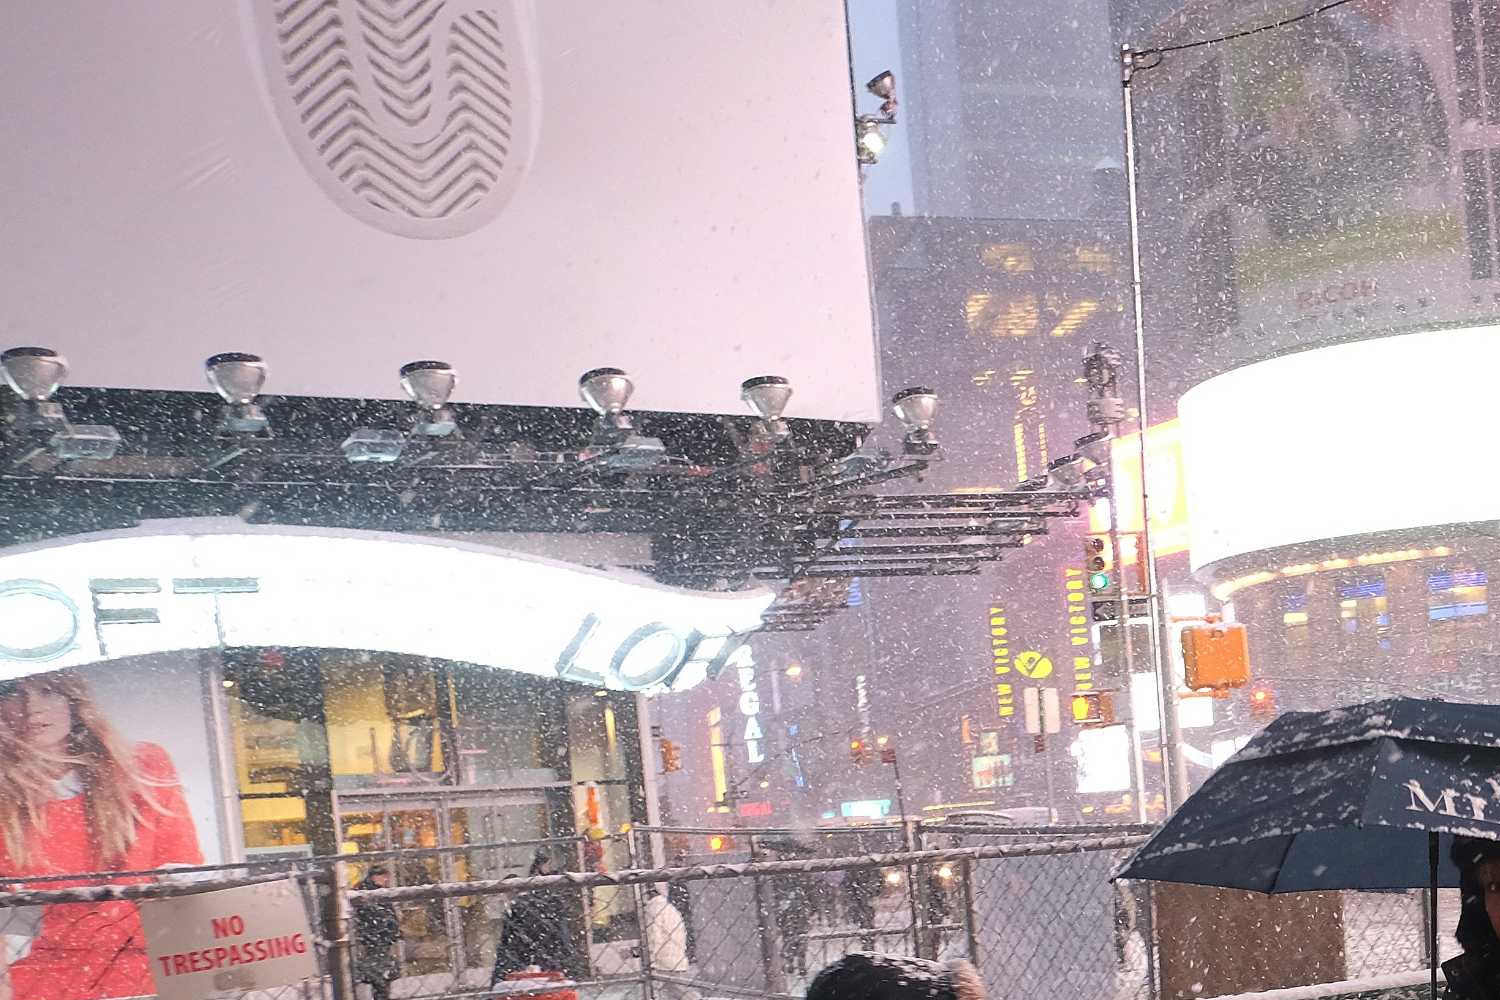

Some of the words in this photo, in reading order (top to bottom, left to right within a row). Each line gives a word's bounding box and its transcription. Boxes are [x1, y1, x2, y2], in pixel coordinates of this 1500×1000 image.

[1065, 568, 1088, 645] VICTORY
[989, 607, 1011, 675] VICTORY
[997, 683, 1014, 717] NEW
[211, 915, 244, 939] NO
[158, 933, 307, 977] TRESPASSING
